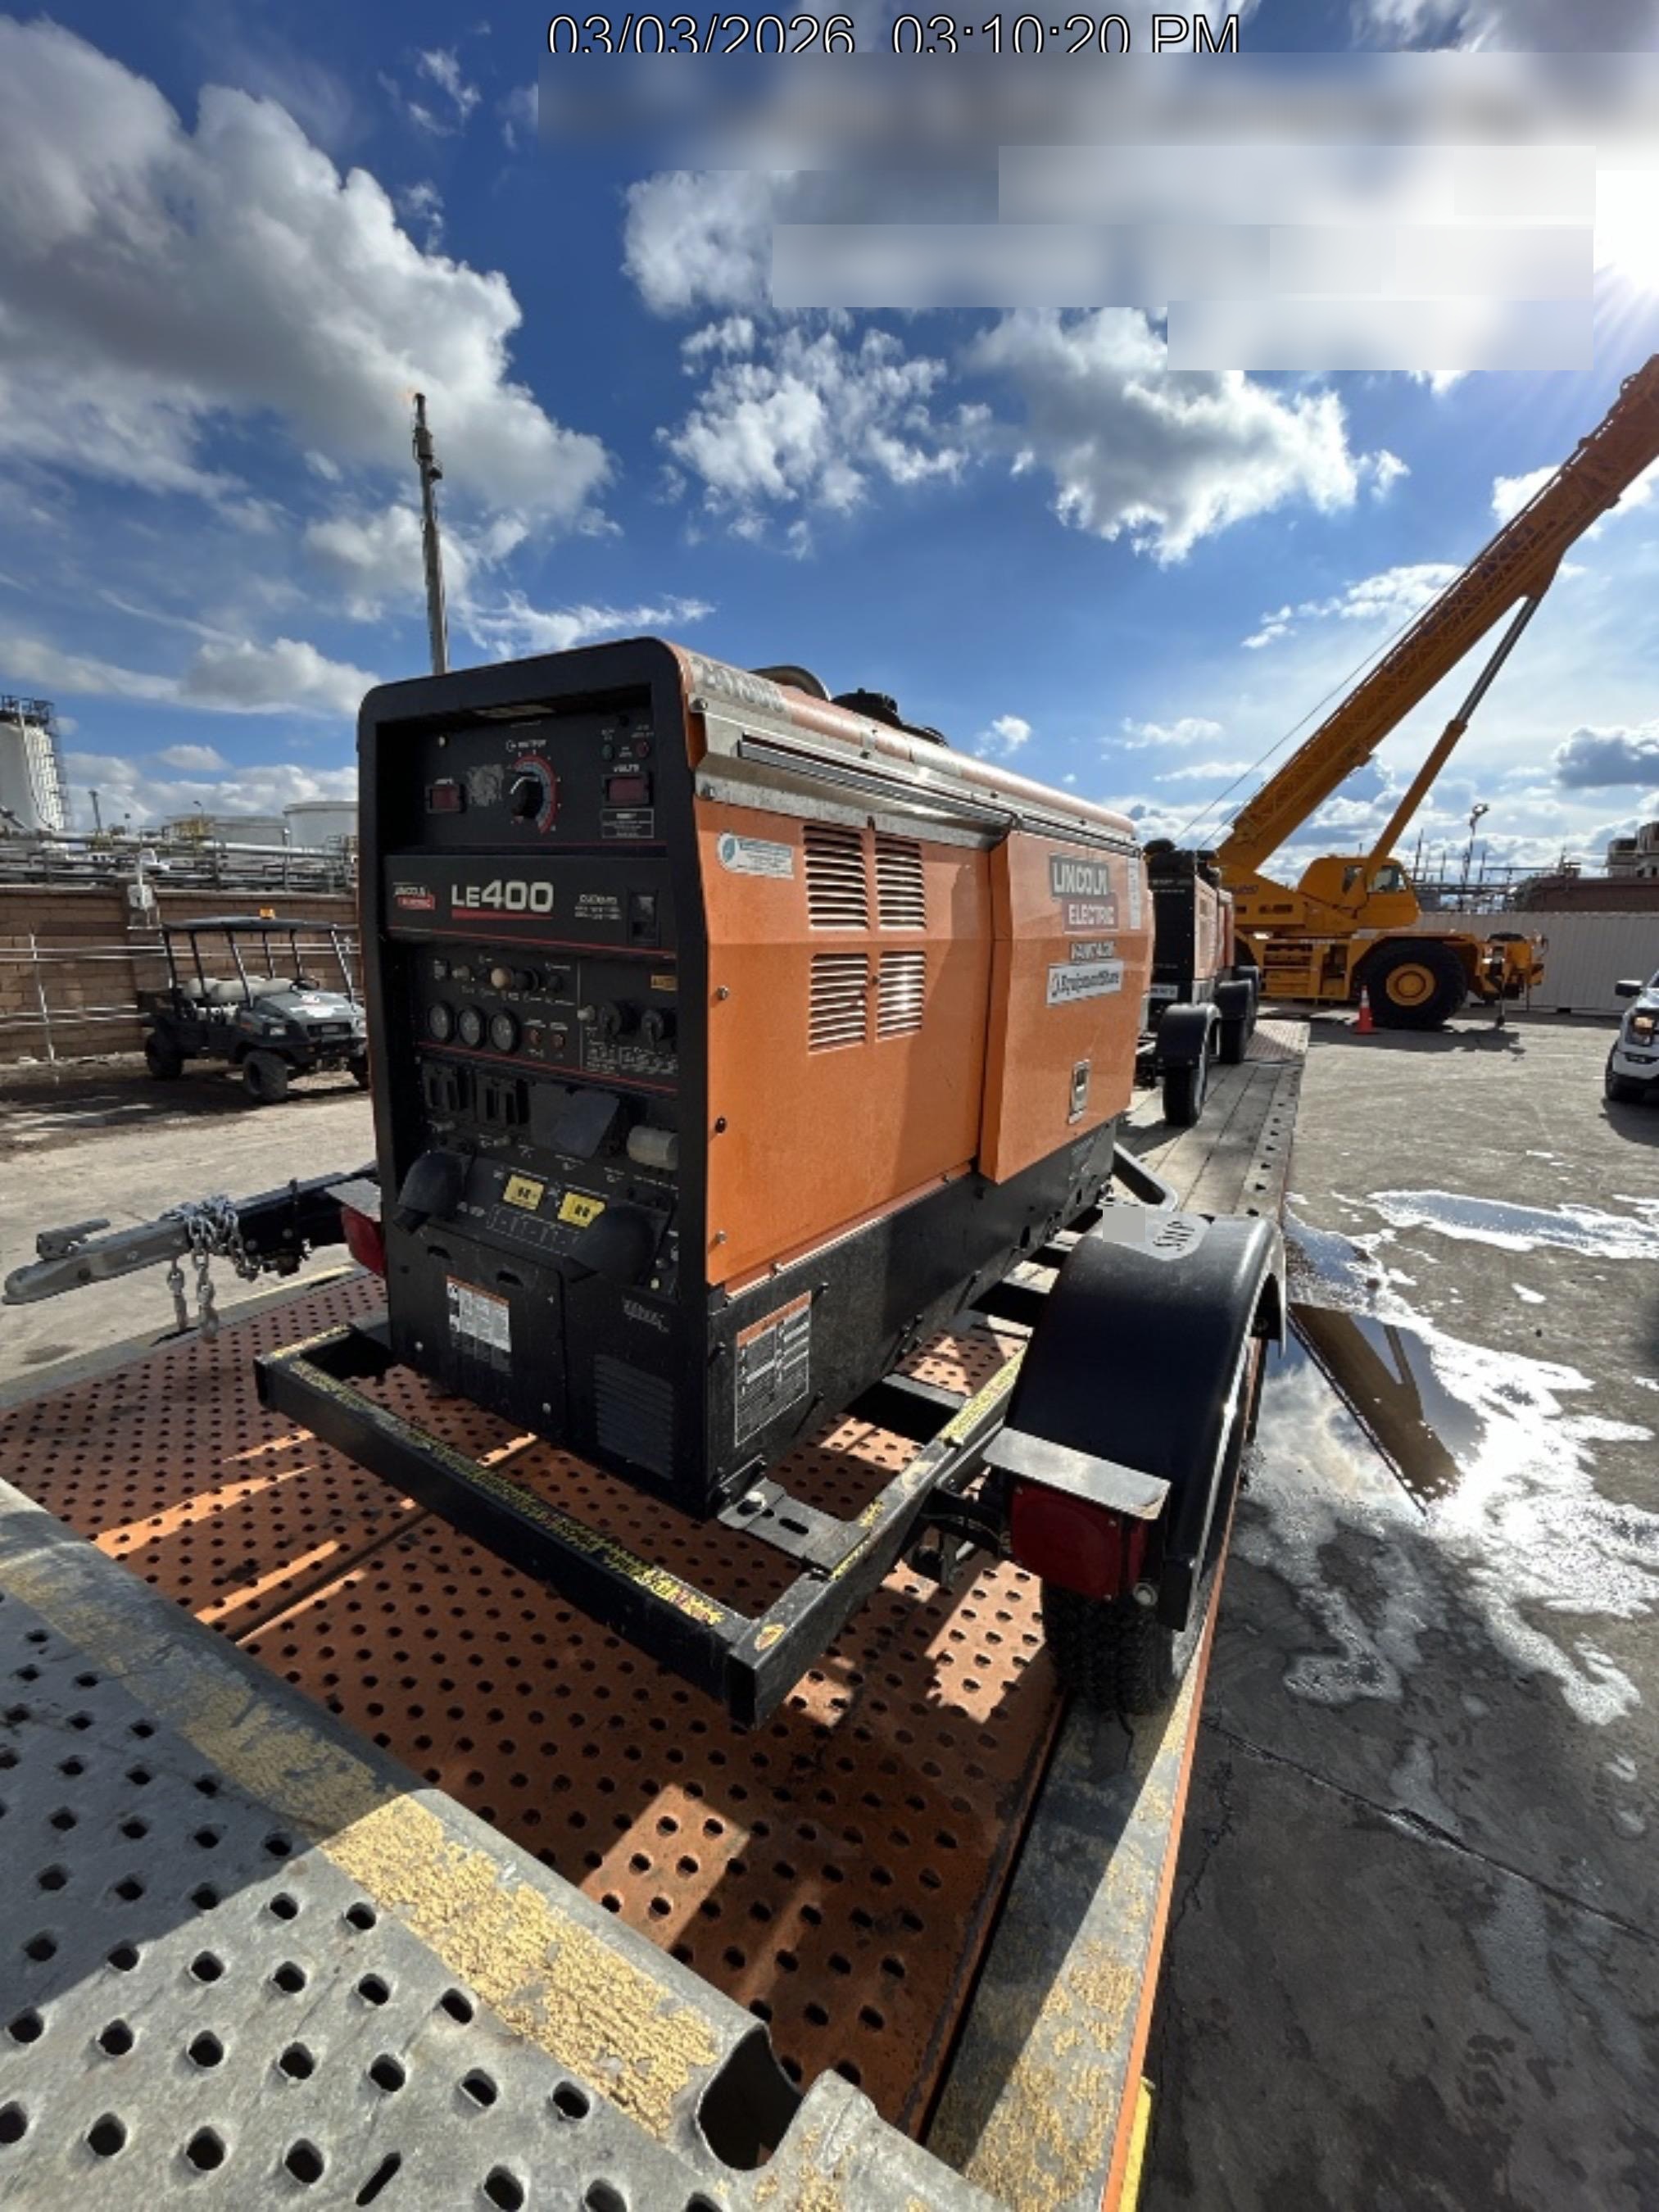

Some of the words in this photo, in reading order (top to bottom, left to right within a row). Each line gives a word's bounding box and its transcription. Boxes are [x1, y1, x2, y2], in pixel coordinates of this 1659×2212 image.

[1054, 862, 1108, 895] LINCOLN
[451, 879, 554, 913] LE400
[1068, 904, 1115, 926] ELECTRIC
